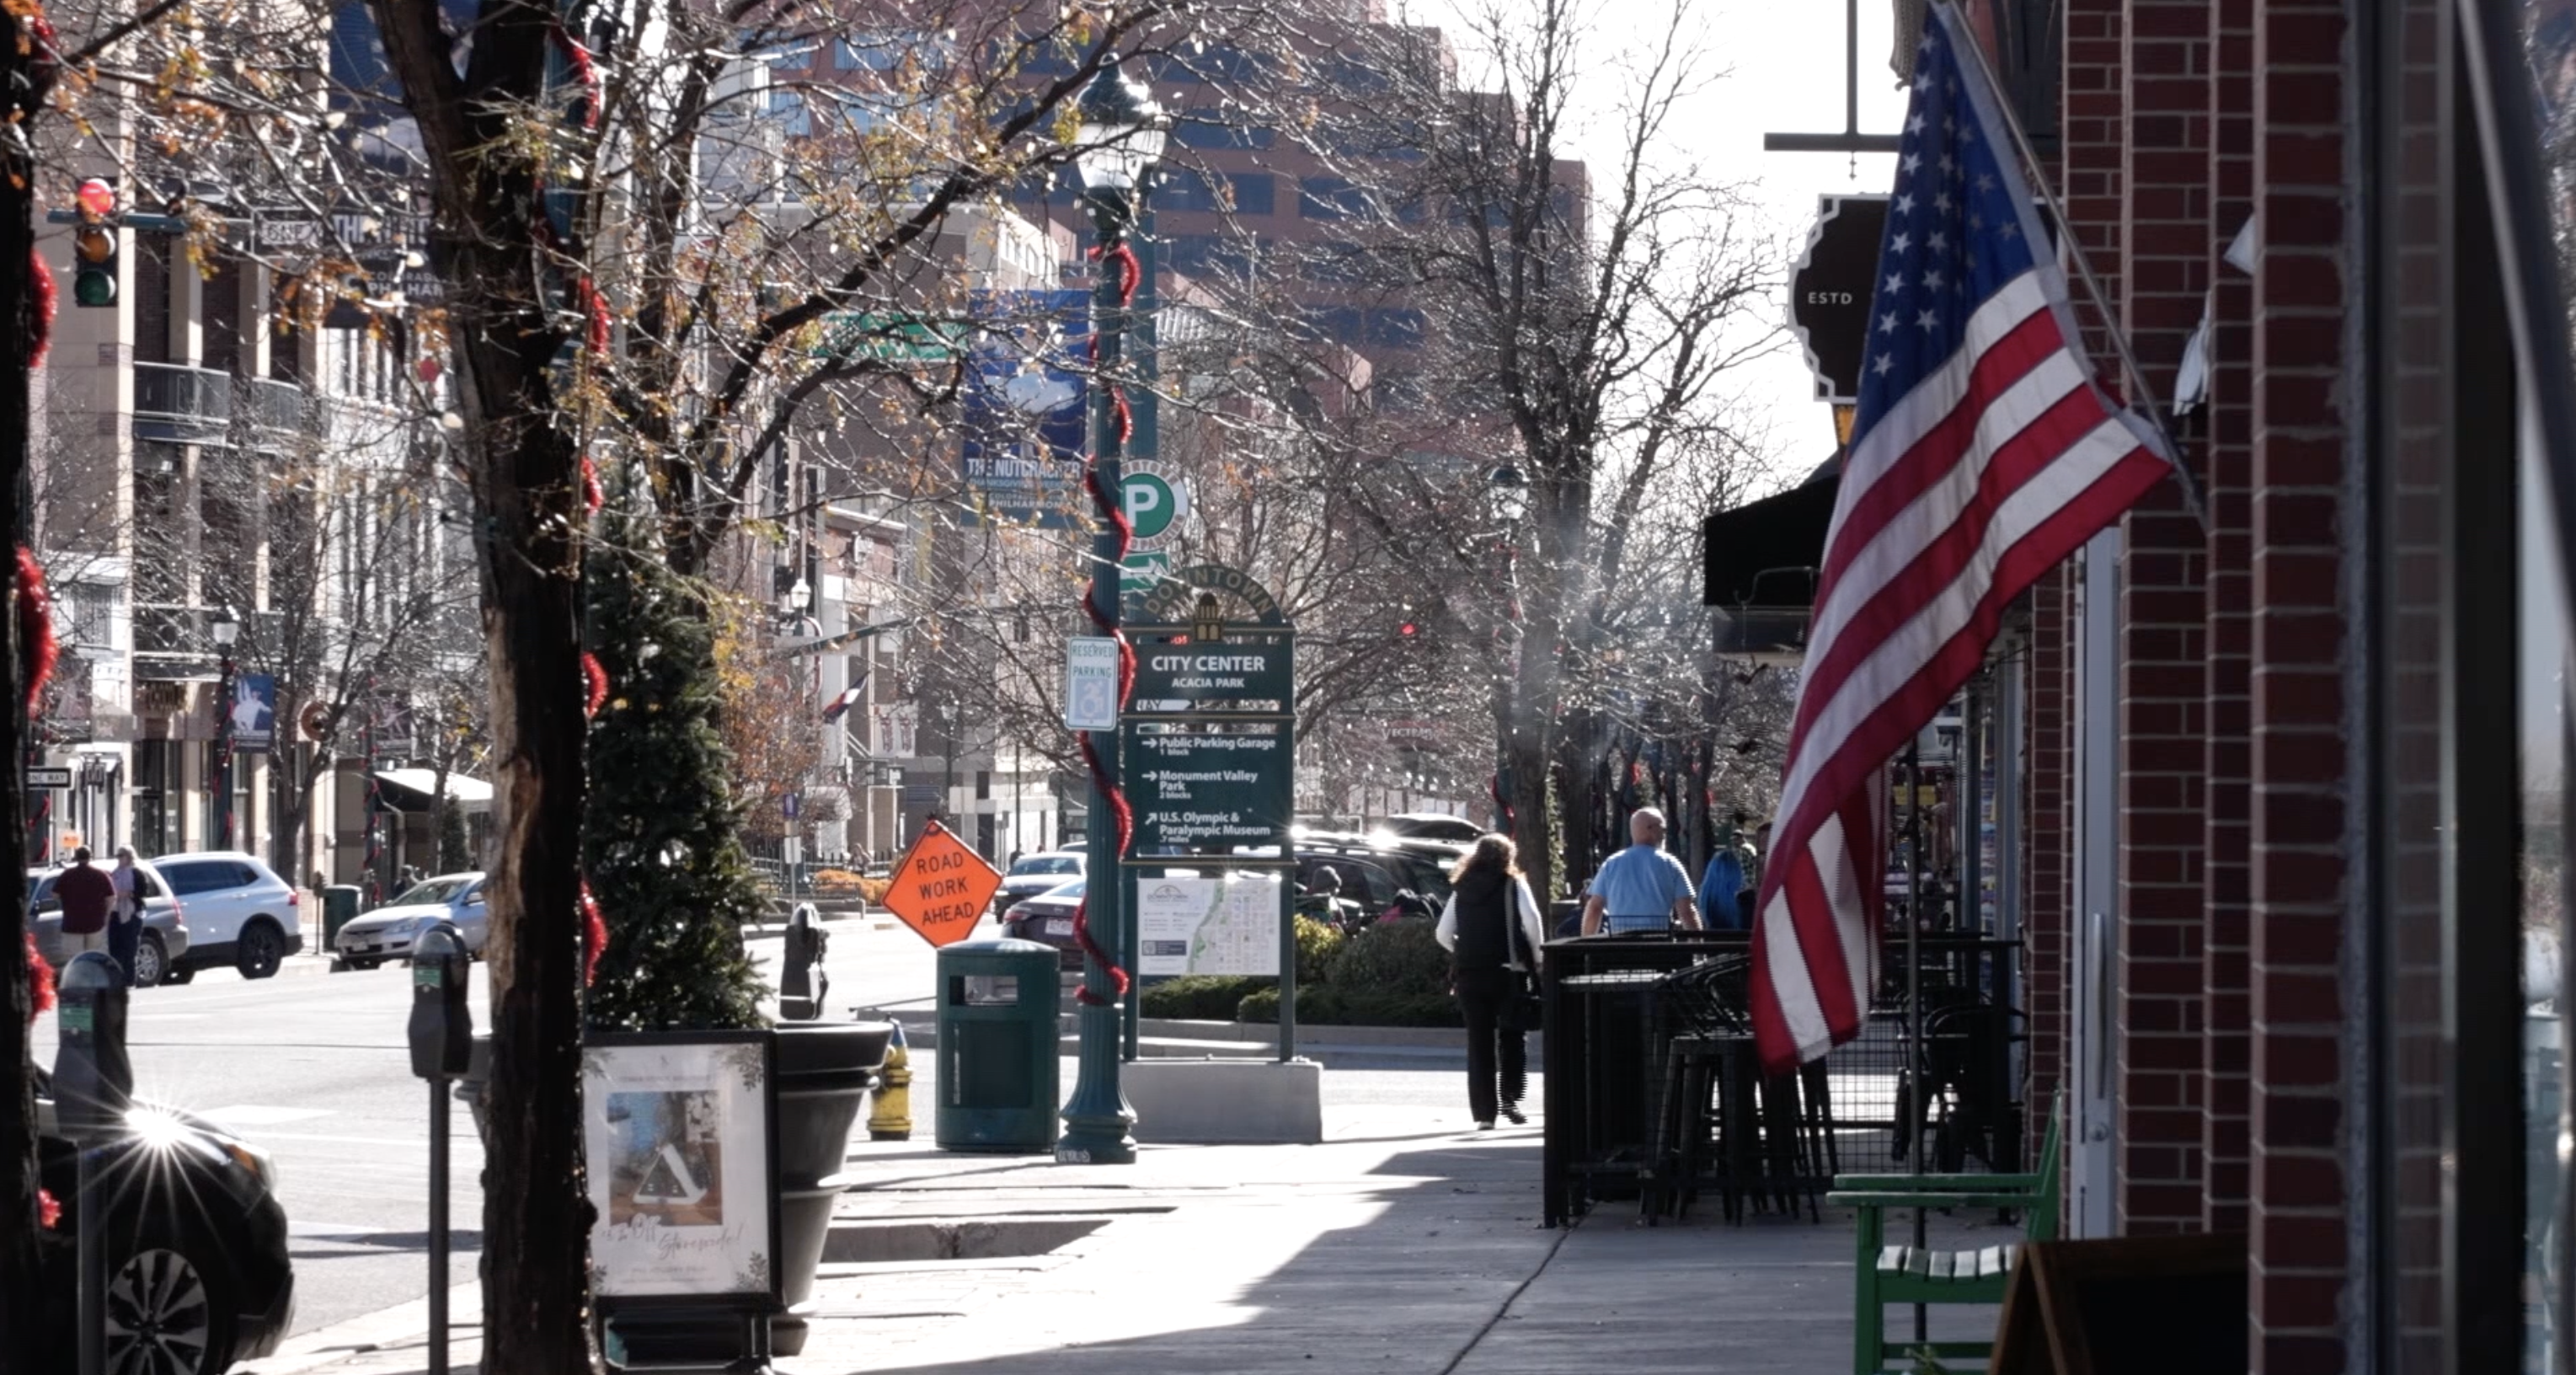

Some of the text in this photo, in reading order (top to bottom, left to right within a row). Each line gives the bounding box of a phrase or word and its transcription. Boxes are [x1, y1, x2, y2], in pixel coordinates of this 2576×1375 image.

[1808, 292, 1852, 304] ESTD
[1125, 484, 1159, 527] P
[1072, 645, 1114, 657] RESERVED
[1151, 655, 1265, 671] CITY CENTER
[1073, 666, 1112, 678] PARKING
[1171, 677, 1244, 688] ACACIA PARK
[1159, 737, 1276, 750] Public Parking Garage
[1159, 770, 1258, 784] Monument Valley
[1159, 781, 1185, 791] Park
[1159, 811, 1240, 825] U.S. Olympic &
[1159, 825, 1270, 837] Paralympic Museum
[917, 852, 963, 875] ROAD
[919, 877, 968, 900] WORK
[922, 902, 974, 926] AHEAD
